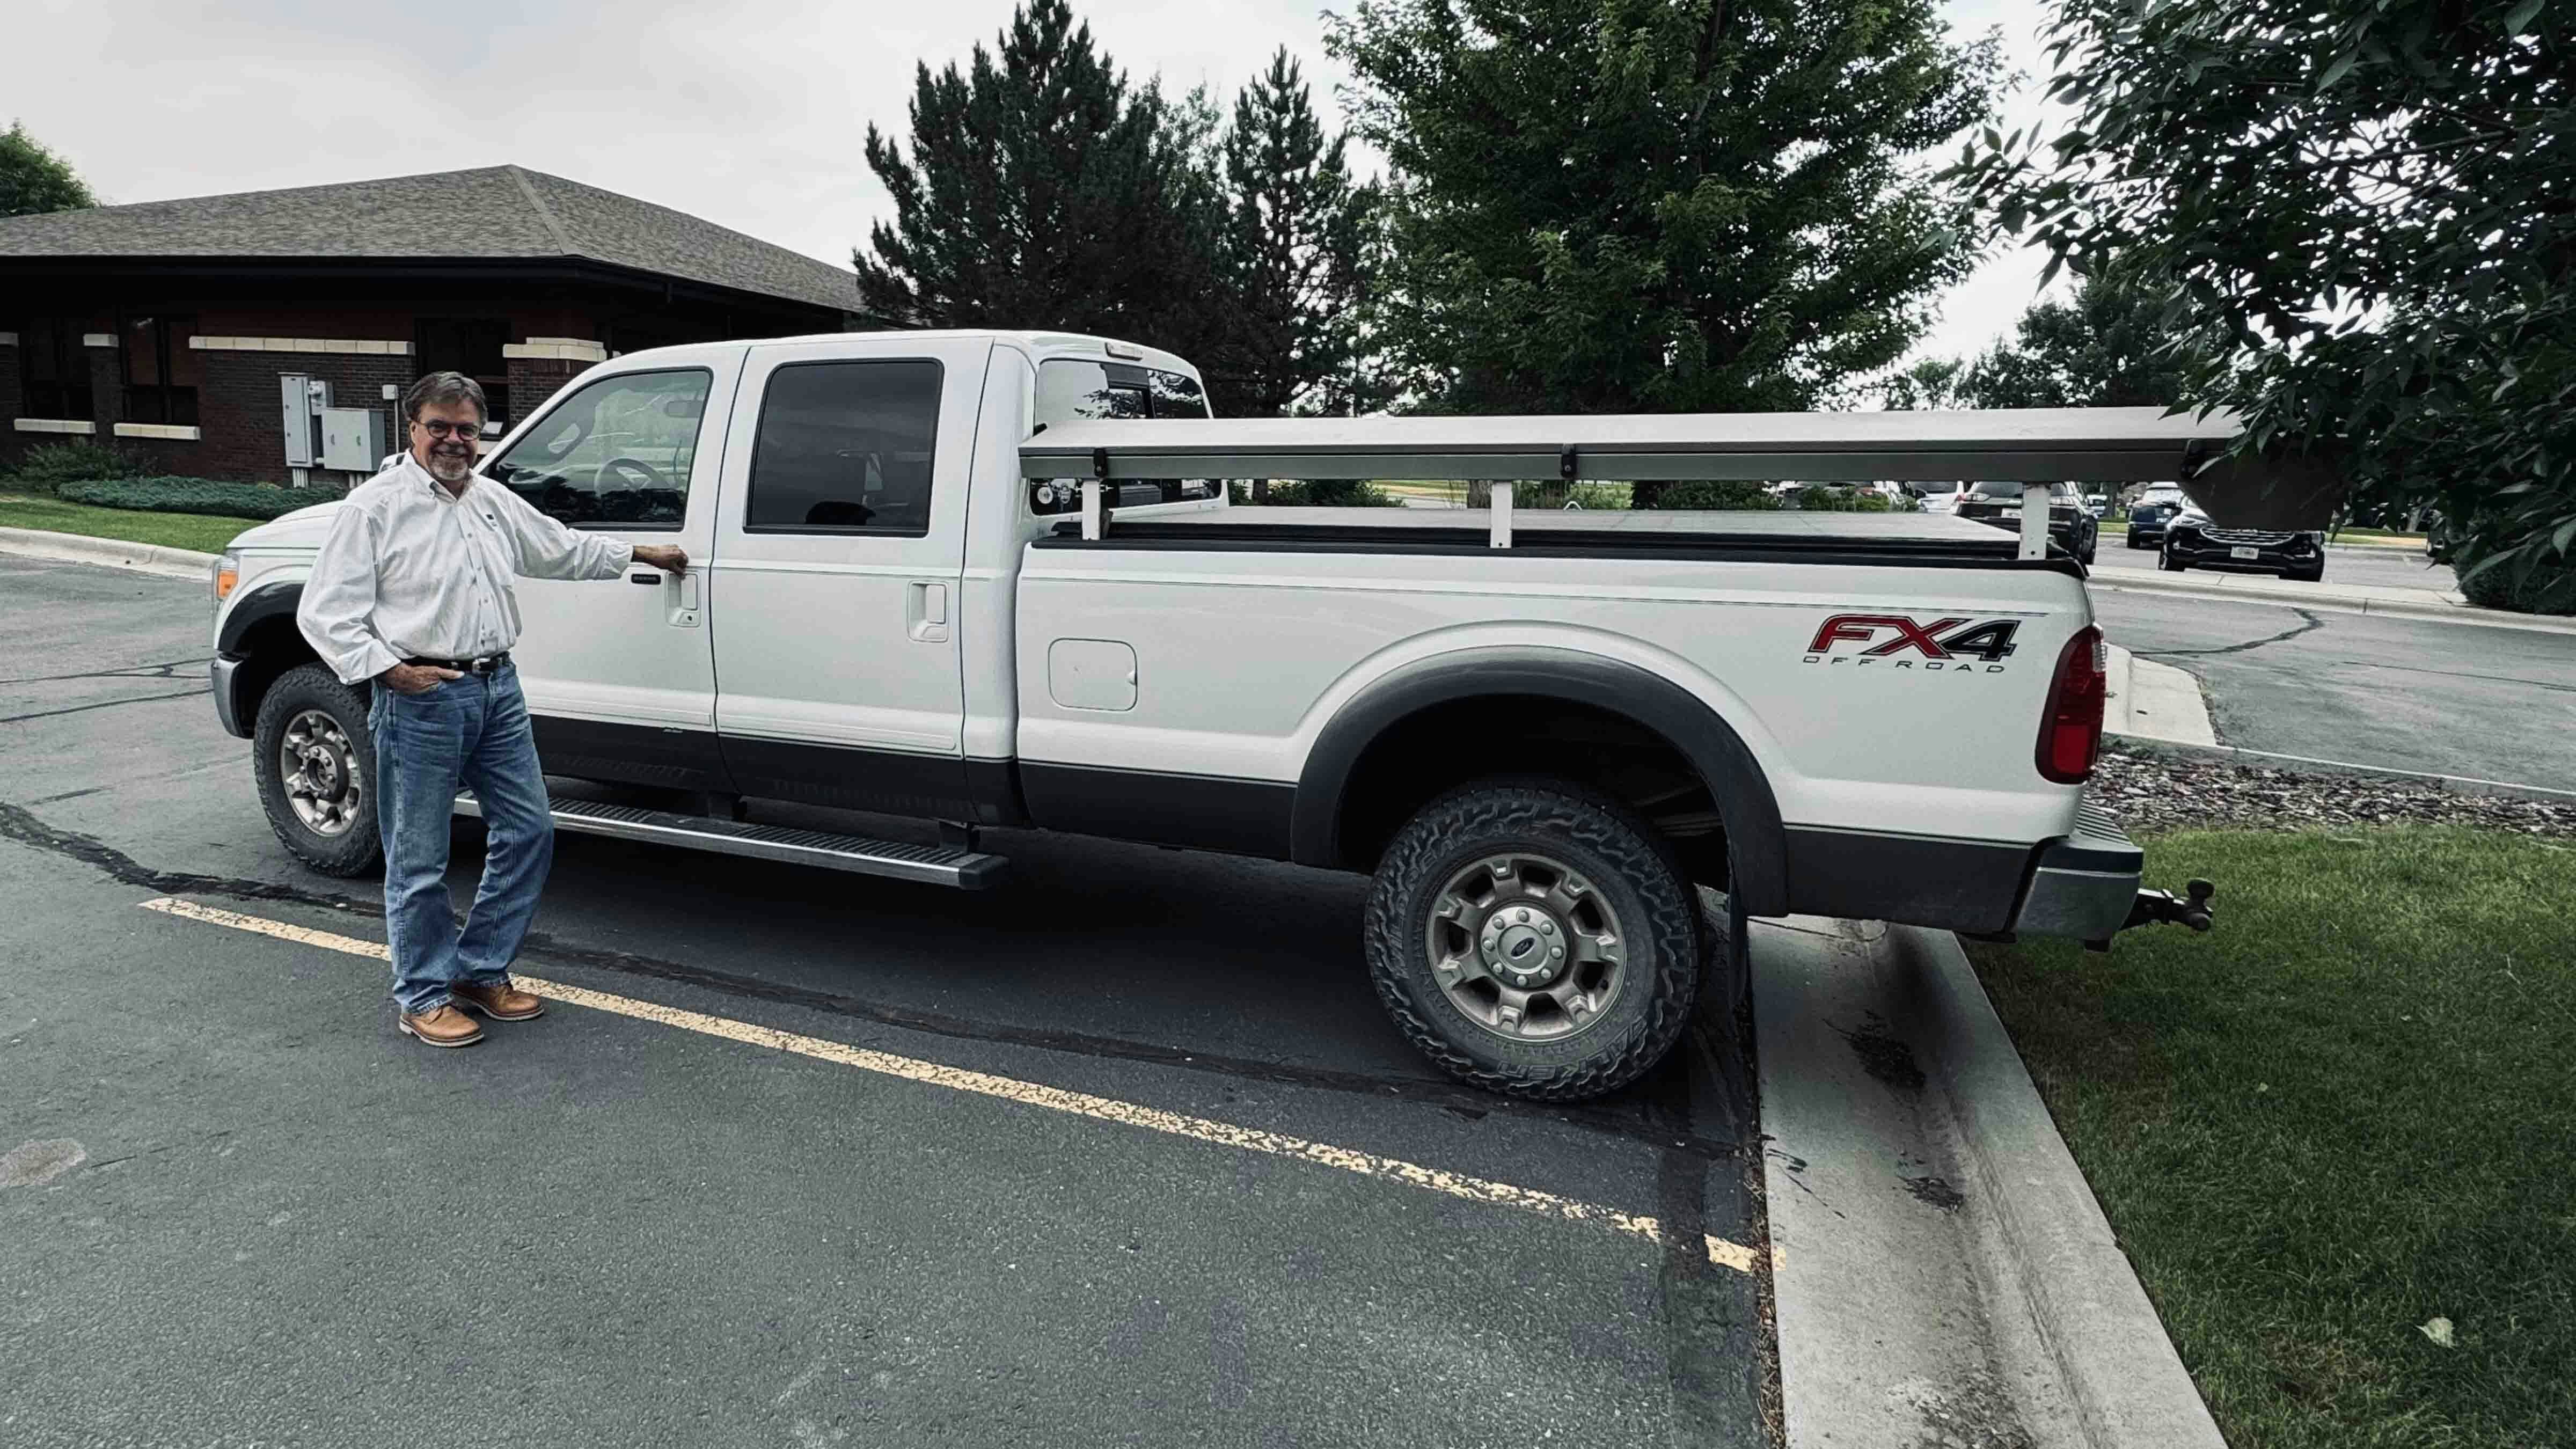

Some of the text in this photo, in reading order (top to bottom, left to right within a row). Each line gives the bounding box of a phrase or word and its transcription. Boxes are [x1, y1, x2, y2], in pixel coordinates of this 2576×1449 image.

[1807, 613, 2021, 661] FX4
[1803, 655, 2006, 674] OFF ROAD
